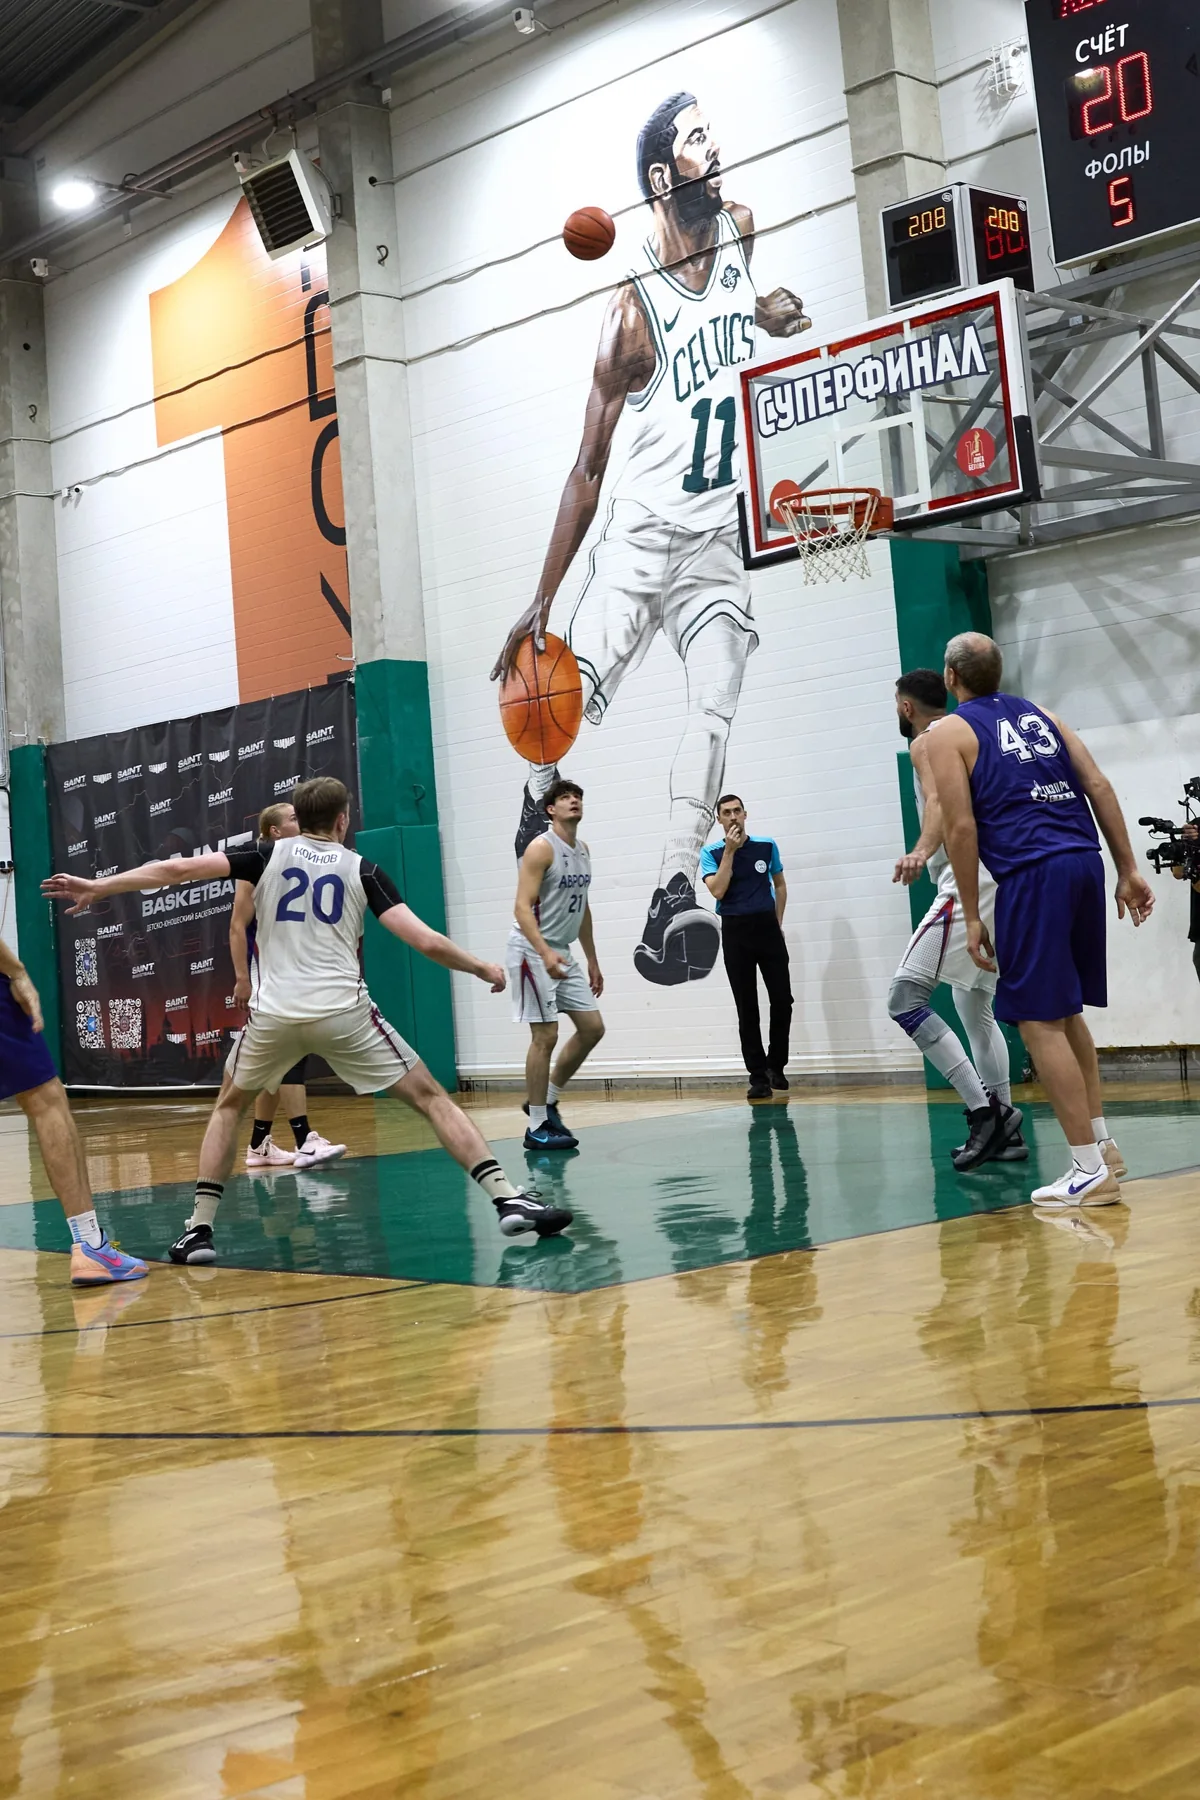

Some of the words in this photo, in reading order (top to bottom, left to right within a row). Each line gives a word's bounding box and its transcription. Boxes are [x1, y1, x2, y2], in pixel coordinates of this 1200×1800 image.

[1075, 23, 1129, 63] СЧЁТ
[1075, 51, 1152, 135] 20
[1084, 140, 1150, 179] ФОЛЫ
[1109, 177, 1134, 227] 5
[673, 312, 754, 402] CELTICS
[757, 324, 990, 438] СУПЕРФИНАЛ
[682, 396, 737, 493] 11
[305, 725, 334, 743] SAINT
[997, 712, 1061, 764] 43
[238, 740, 265, 756] SAINT
[177, 753, 202, 768] SAINT
[117, 764, 142, 779] SAINT
[63, 775, 86, 789] SAINT
[273, 775, 301, 791] SAINT
[208, 787, 233, 803] SAINT
[149, 798, 171, 813] SAINT
[93, 811, 116, 825] SAINT
[67, 840, 88, 854] SAINT
[294, 846, 338, 863] КОЙНОВ
[558, 874, 591, 888] АВРОР
[142, 879, 236, 917] BASKETBA
[275, 867, 344, 924] 20
[568, 894, 583, 913] 21
[96, 923, 123, 935] SAINT
[131, 962, 155, 975] SAINT
[190, 957, 214, 971] SAINT
[165, 995, 188, 1008] SAINT
[195, 1029, 220, 1041] SAINT
